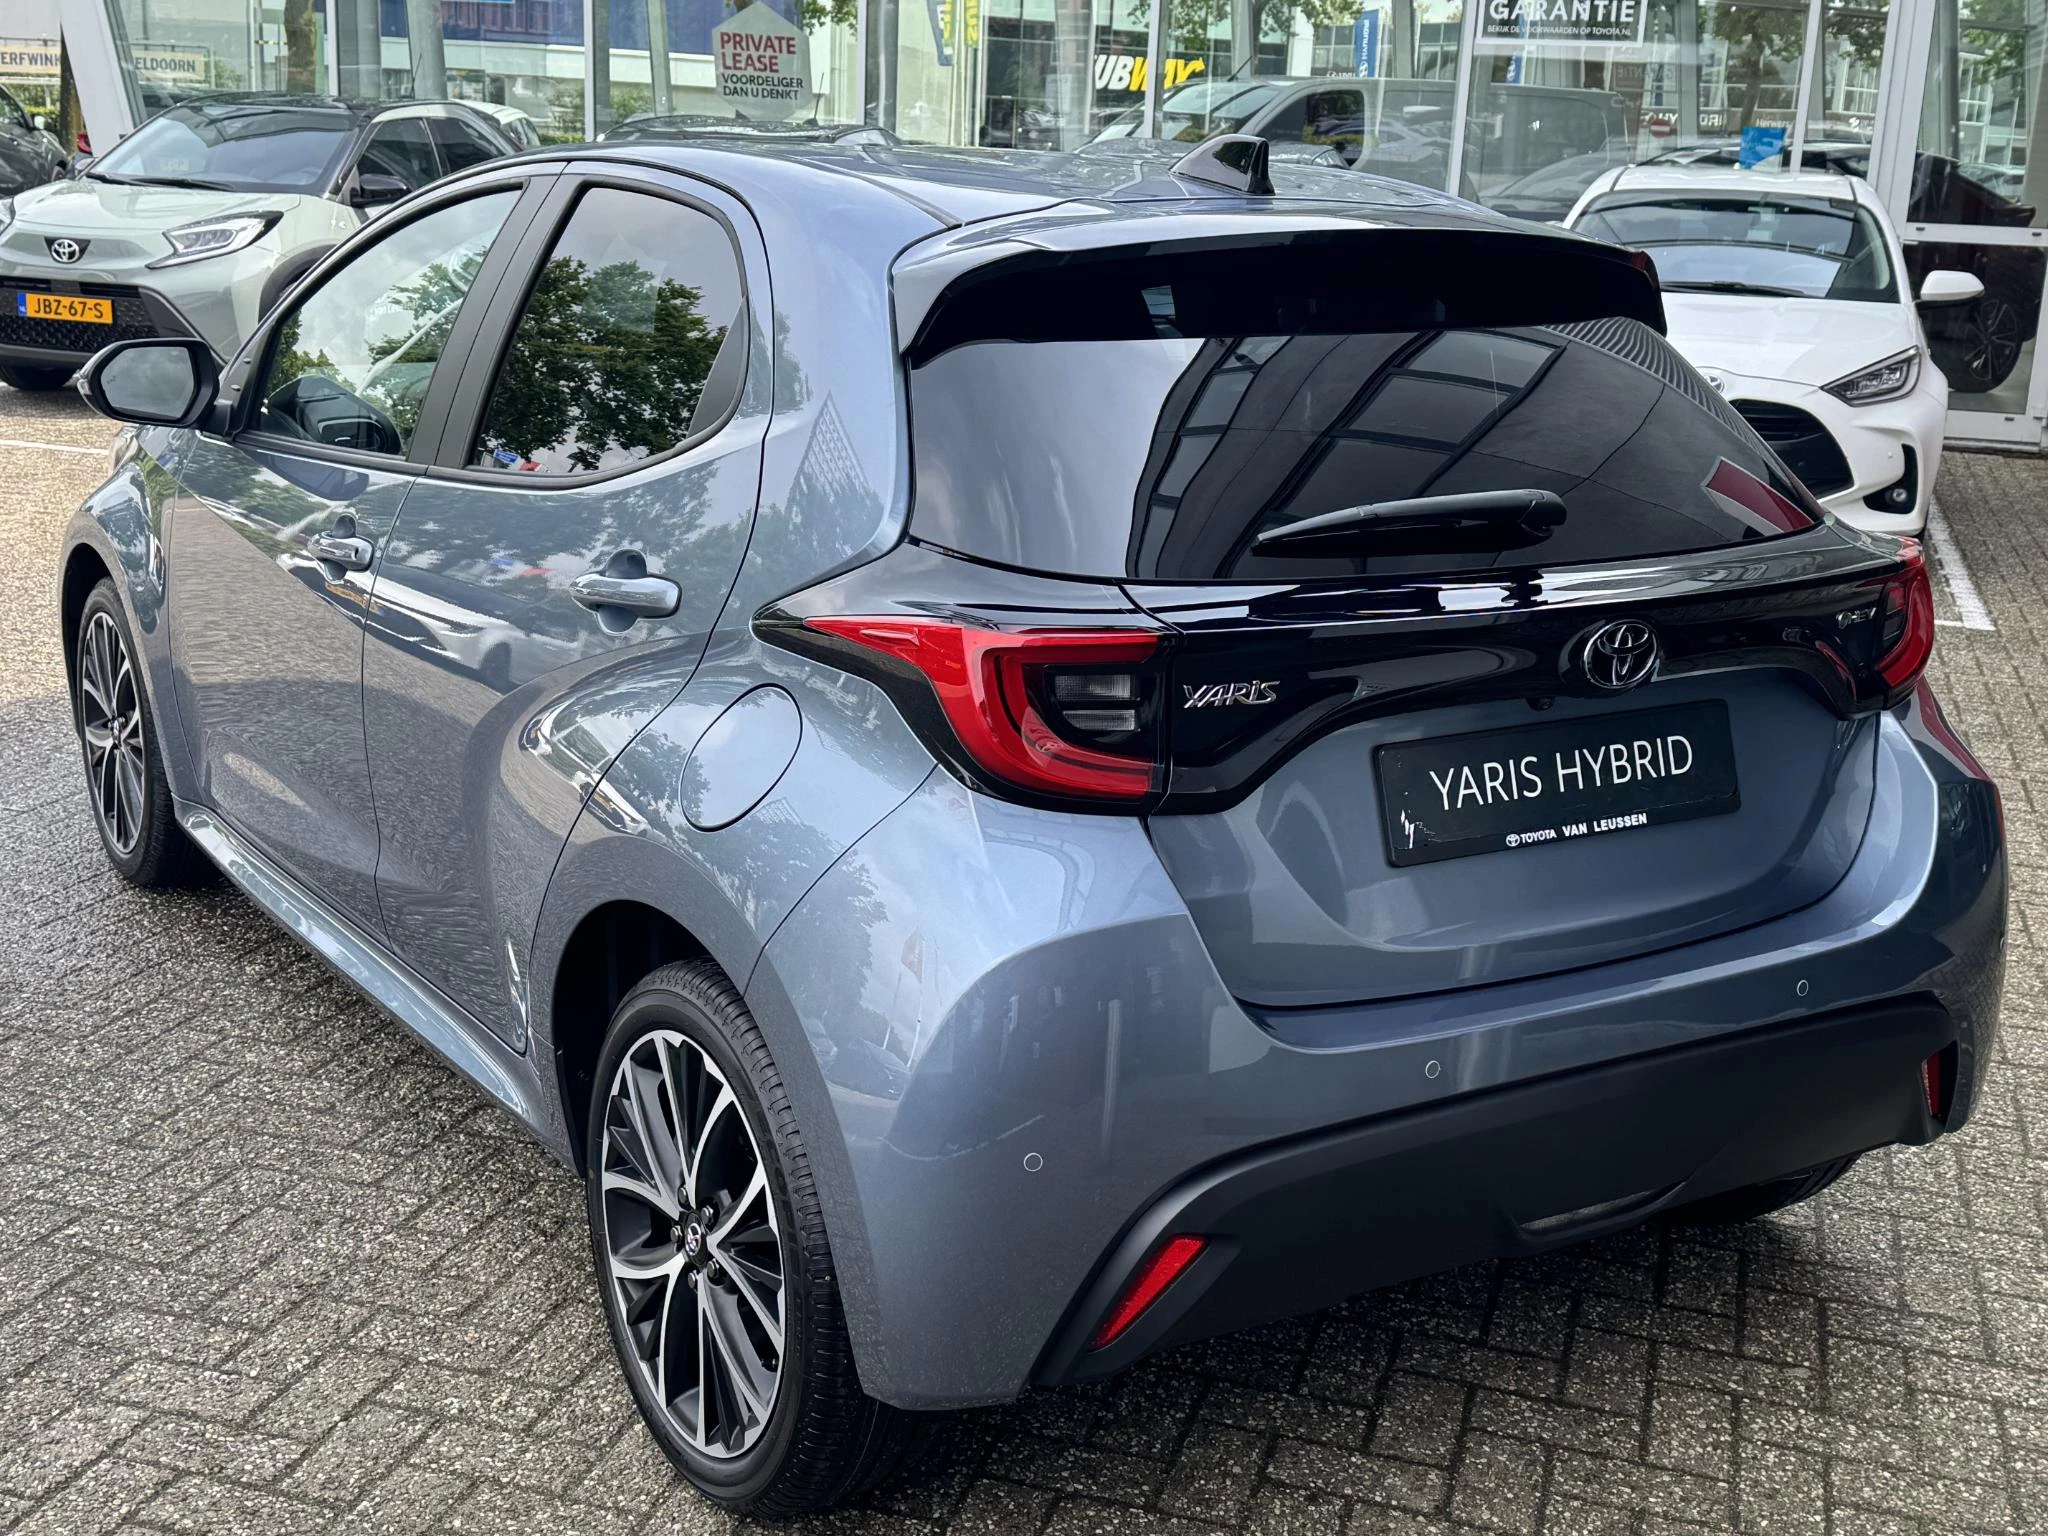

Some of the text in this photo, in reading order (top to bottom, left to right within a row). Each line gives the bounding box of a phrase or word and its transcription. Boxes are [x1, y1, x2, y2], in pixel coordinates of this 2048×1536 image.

[1489, 0, 1635, 22] GARANTIE
[720, 32, 796, 55] PRIVATE
[721, 52, 779, 73] LEASE
[722, 73, 803, 88] VOORDELIGER
[723, 86, 799, 100] DAN U DENKT
[34, 298, 104, 319] JBZ-67-S
[1429, 735, 1693, 811] YARIS HYBRID
[1520, 812, 1648, 844] TOYOTA VAN LEUSSEN
